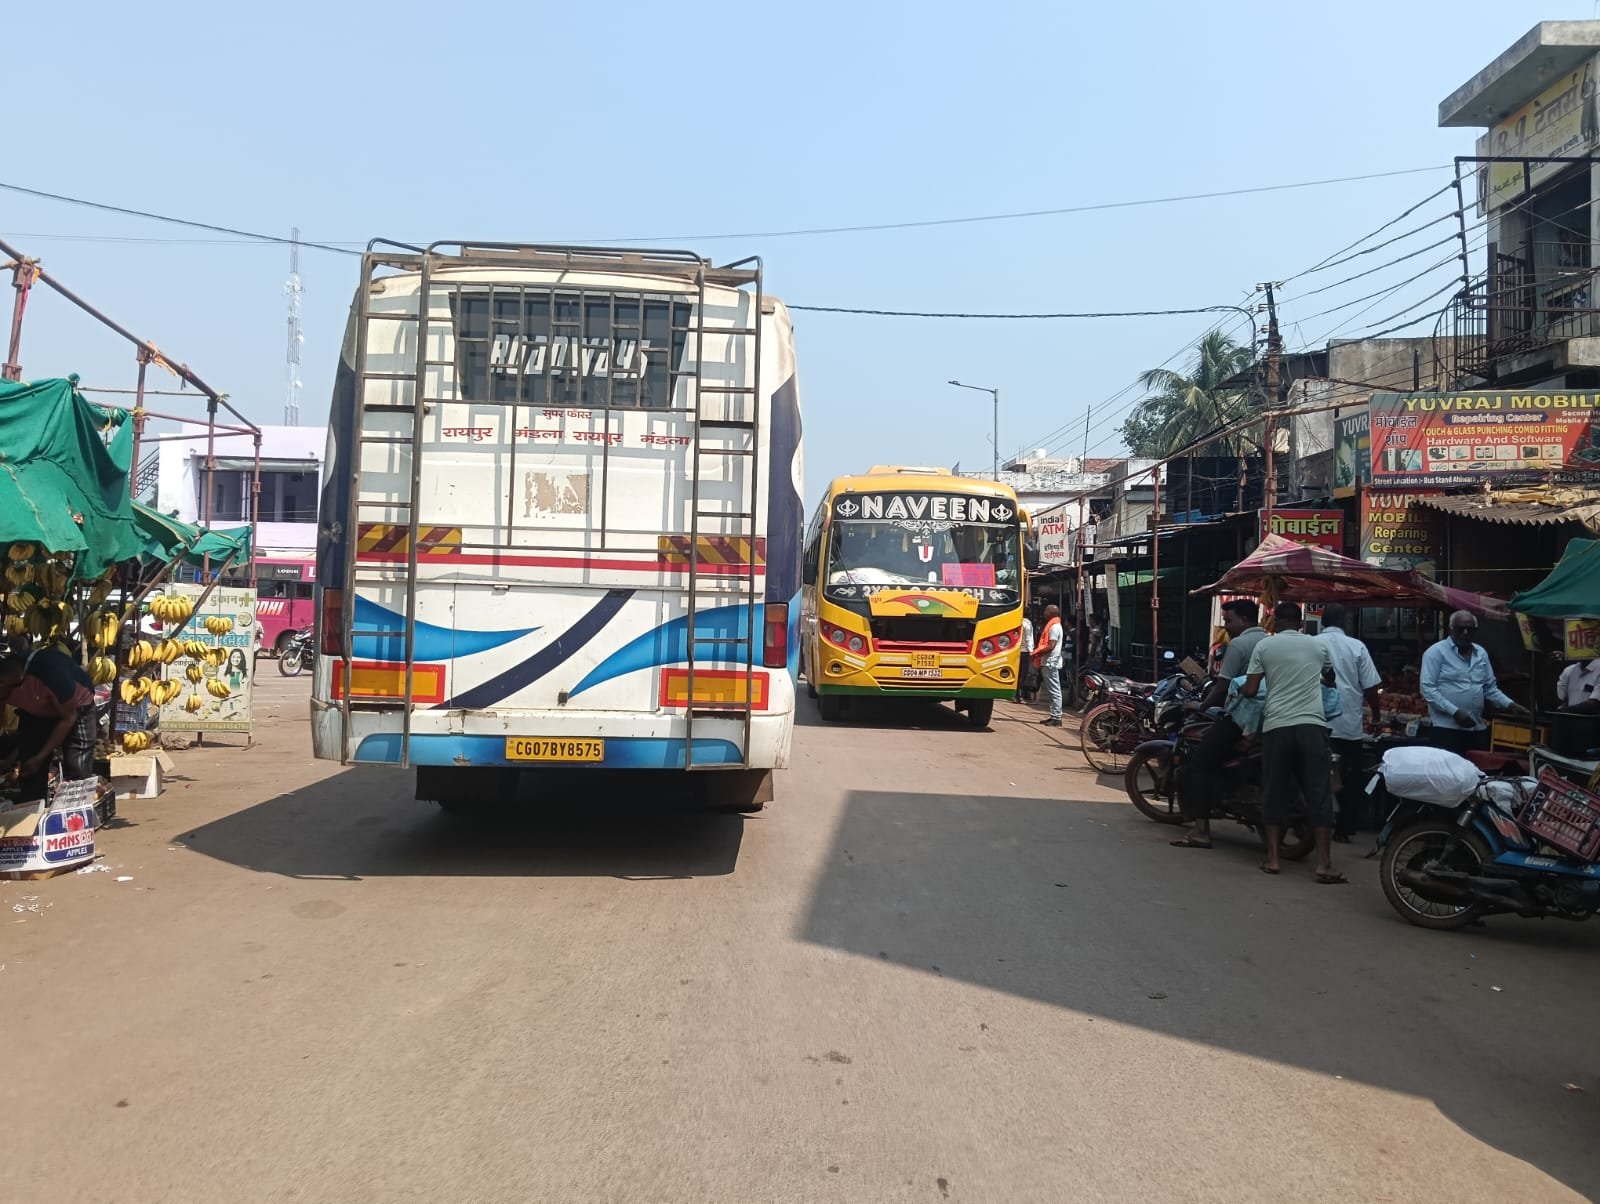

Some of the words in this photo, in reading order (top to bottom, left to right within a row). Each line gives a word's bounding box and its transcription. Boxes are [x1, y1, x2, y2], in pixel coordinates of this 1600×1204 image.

[1403, 396, 1502, 411] YUVRAJ
[1342, 415, 1369, 436] YUVR
[1452, 414, 1504, 424] Repairing
[1506, 413, 1543, 422] Center
[443, 427, 493, 441] रायपुर
[573, 431, 623, 445] रायपुर
[641, 432, 689, 445] मंडला
[1454, 427, 1476, 435] GLASS
[1477, 426, 1513, 434] PUNCHING
[1514, 425, 1540, 433] COMBO
[1541, 425, 1568, 433] FITTING
[1427, 437, 1482, 445] Hardware
[1485, 435, 1508, 443] And
[1511, 435, 1562, 443] Software
[1368, 493, 1426, 509] YUVR
[861, 496, 990, 522] NAVEEN
[1041, 524, 1065, 535] ATM
[1263, 514, 1340, 536] मोबाईल
[1374, 526, 1428, 541] Reparing
[1369, 542, 1431, 553] Center
[516, 741, 601, 757] CG07BY8575
[66, 846, 88, 857] APPLES
